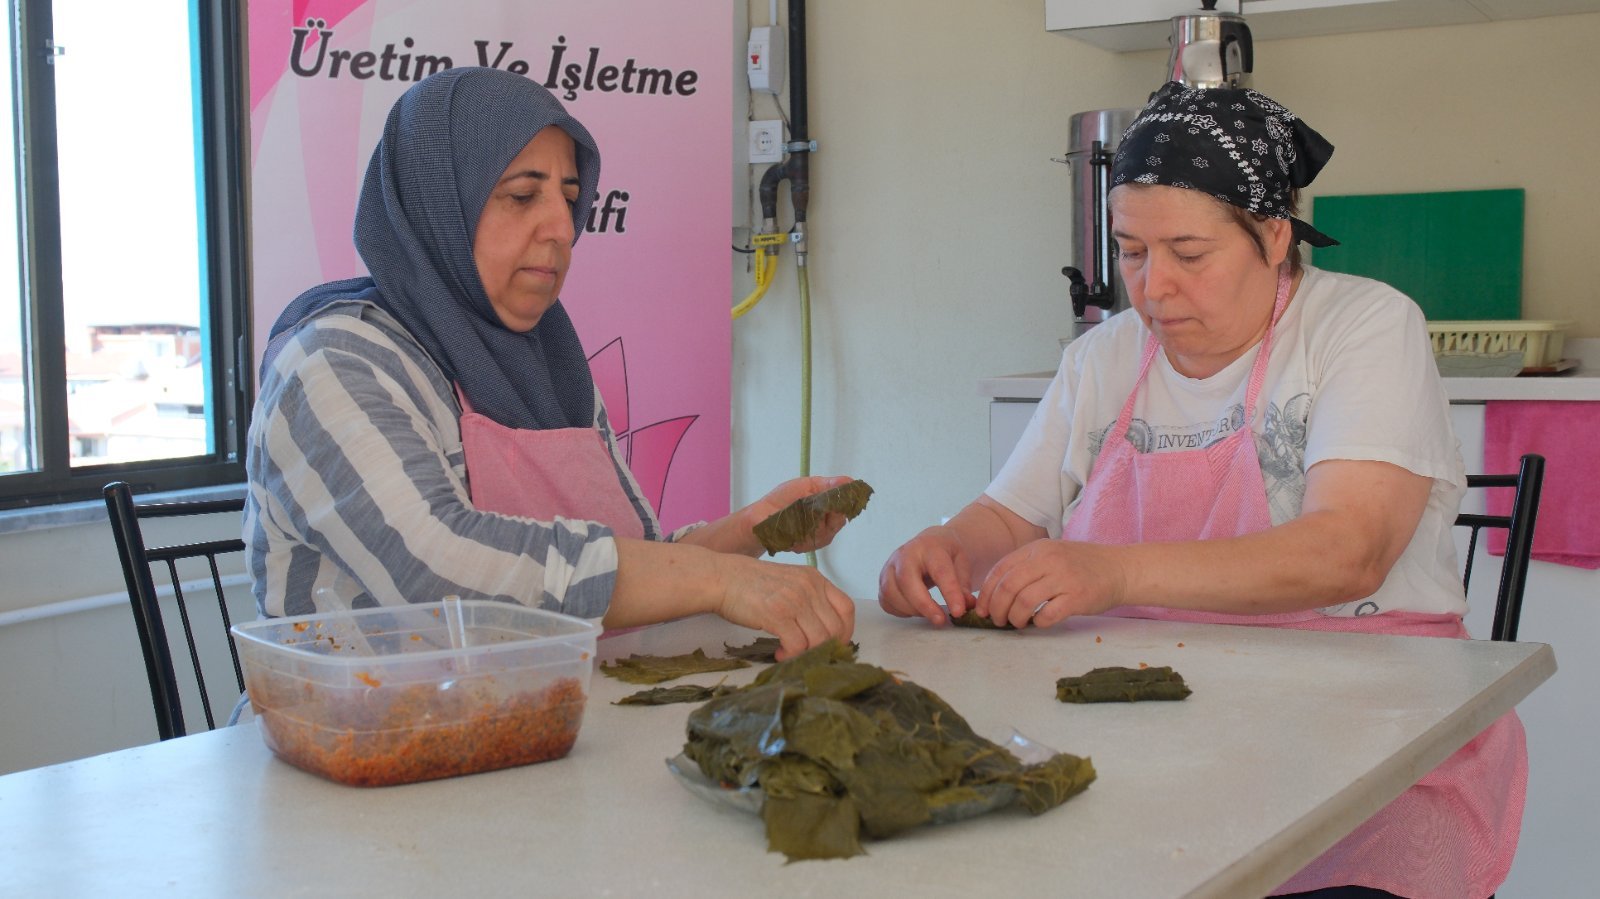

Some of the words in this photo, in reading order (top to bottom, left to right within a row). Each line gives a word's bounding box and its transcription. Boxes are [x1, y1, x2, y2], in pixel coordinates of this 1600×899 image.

[290, 19, 453, 82] Üretim
[543, 35, 698, 101] İşletme
[585, 189, 630, 233] ifi
[1157, 417, 1231, 449] INVENTR
